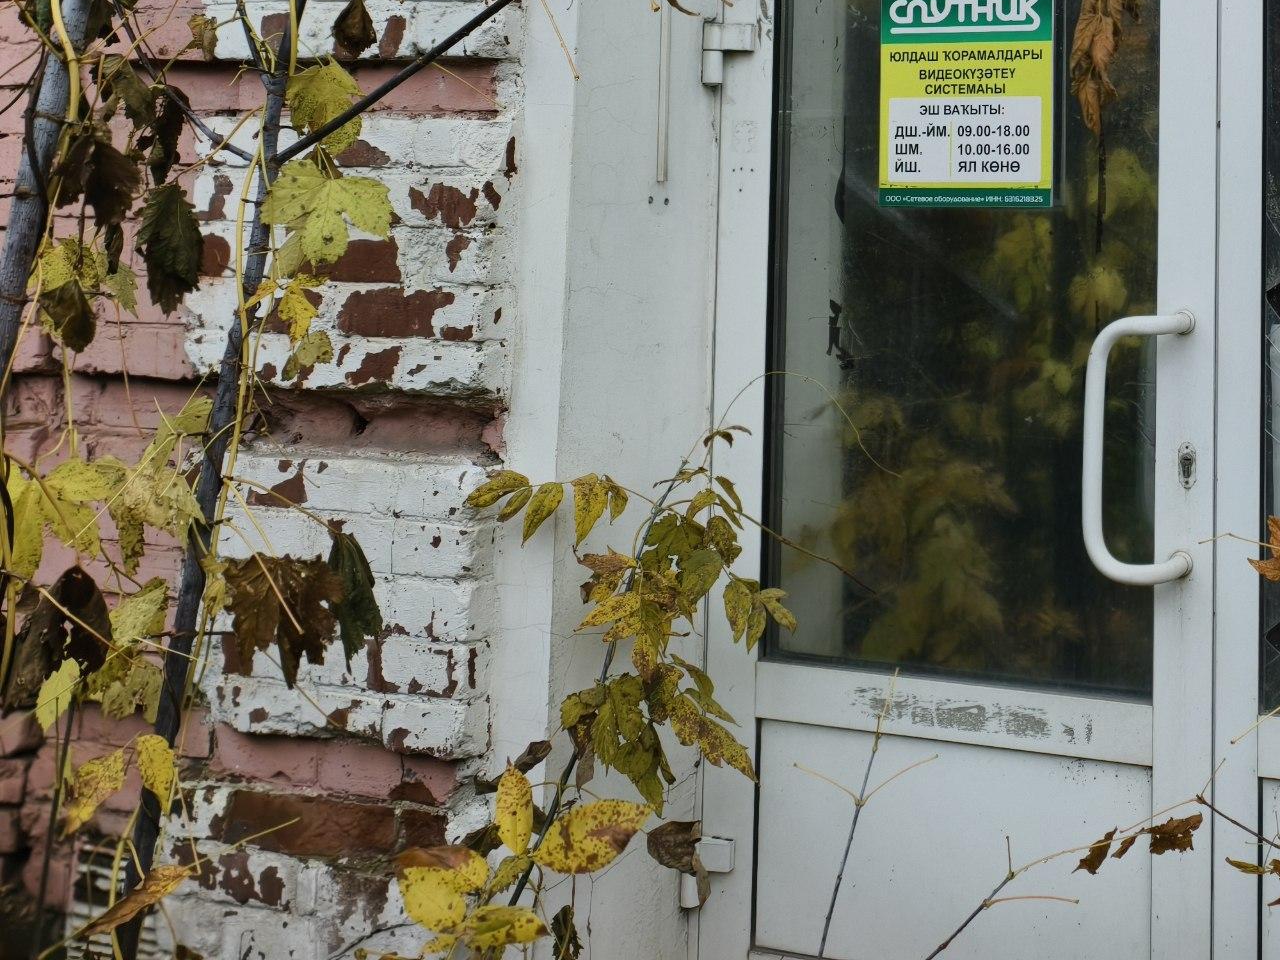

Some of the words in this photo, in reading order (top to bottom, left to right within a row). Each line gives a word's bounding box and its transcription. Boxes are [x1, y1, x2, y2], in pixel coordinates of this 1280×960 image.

[890, 51, 938, 63] ЮЛДАШ
[925, 84, 1005, 94] СИСТЕМАҺЫ
[920, 105, 939, 115] ЭШ
[944, 104, 1004, 115] ВАҠЫТЫ:
[895, 123, 950, 139] ДШ.-ЙМ.
[958, 125, 1029, 137] 09.00-18.00
[895, 144, 922, 155] ШМ.
[958, 144, 1029, 155] 10.00-16.00
[895, 159, 921, 173] ЙШ.
[958, 161, 977, 172] ЯЛ
[981, 161, 1020, 172] КӨНӨ
